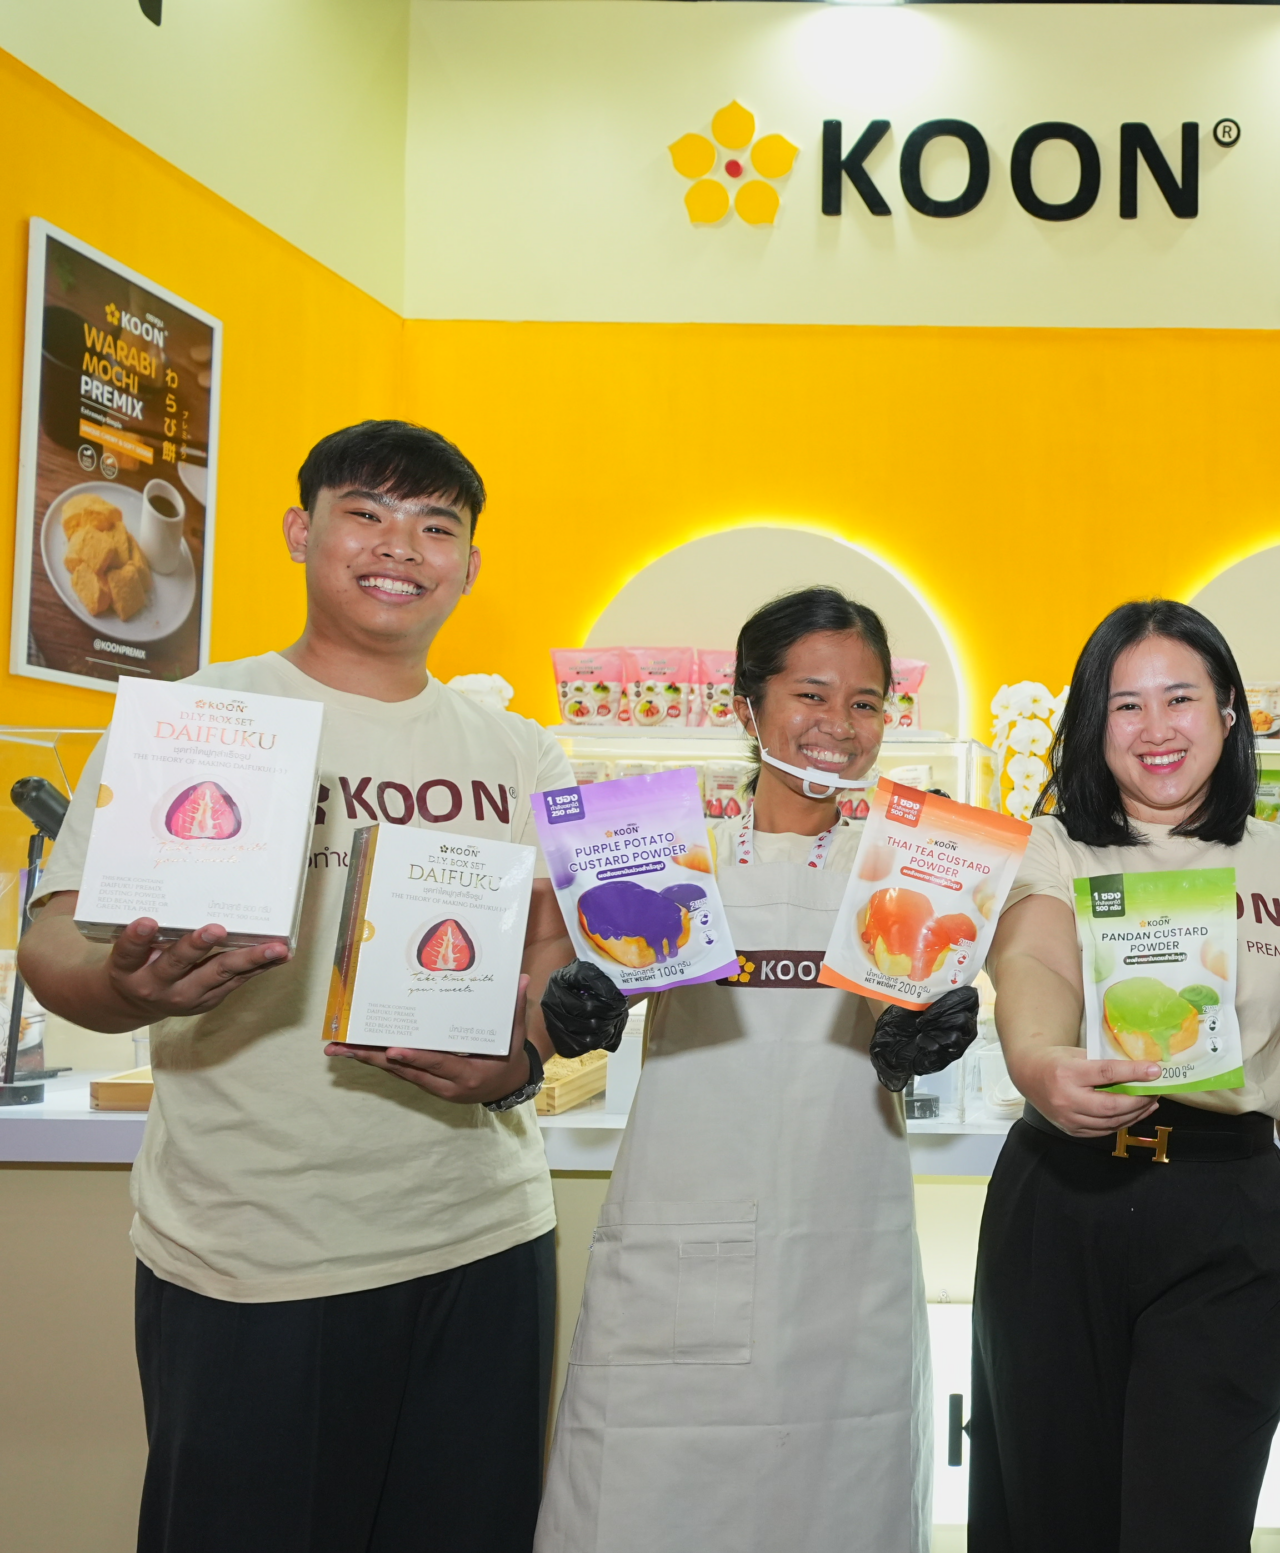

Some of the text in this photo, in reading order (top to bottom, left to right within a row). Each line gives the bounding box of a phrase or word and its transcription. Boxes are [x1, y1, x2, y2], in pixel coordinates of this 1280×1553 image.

[83, 322, 157, 379] WARABI
[82, 351, 139, 395] MOCHI
[80, 374, 144, 420] PREMIX
[93, 637, 147, 660] @KOONPREMIX
[209, 714, 232, 725] BOX
[234, 717, 255, 727] SET
[153, 720, 278, 750] DAIFUKU
[546, 793, 579, 806] 1 ซอง
[893, 795, 920, 810] 1 ซอง
[551, 807, 580, 818] 250 กรัม
[890, 808, 917, 821] 500 กรัม
[613, 826, 639, 837] KOON
[449, 846, 479, 858] KOON
[575, 832, 675, 858] PURPLE POTATO
[933, 840, 957, 851] KOON
[569, 844, 687, 873] CUSTARD POWDER
[887, 835, 991, 875] THAI TEA CUSTARD
[450, 858, 469, 869] BOX
[470, 861, 486, 871] SET
[909, 856, 959, 878] POWDER
[407, 863, 502, 892] DAIFUKU
[391, 892, 469, 908] THE THEORY OF MAKING
[1093, 891, 1121, 901] 1 ซอง
[1147, 918, 1170, 927] KOON
[1102, 926, 1209, 942] PANDAN CUSTARD
[1130, 941, 1180, 953] POWDER
[620, 960, 692, 979] น้ำหนักสุทธิ 100 กรัม
[760, 960, 824, 981] KOO
[633, 974, 656, 983] WEIGHT
[864, 976, 897, 991] NET WEIGHT
[866, 967, 931, 996] น้ำหนักสุทธิ 200 กรัม
[365, 1015, 418, 1025] DUSTING POWDER
[366, 1008, 415, 1018] DAIFUKU PREMIX
[363, 1027, 384, 1035] GREEN
[1162, 1063, 1195, 1079] 200 กรัม
